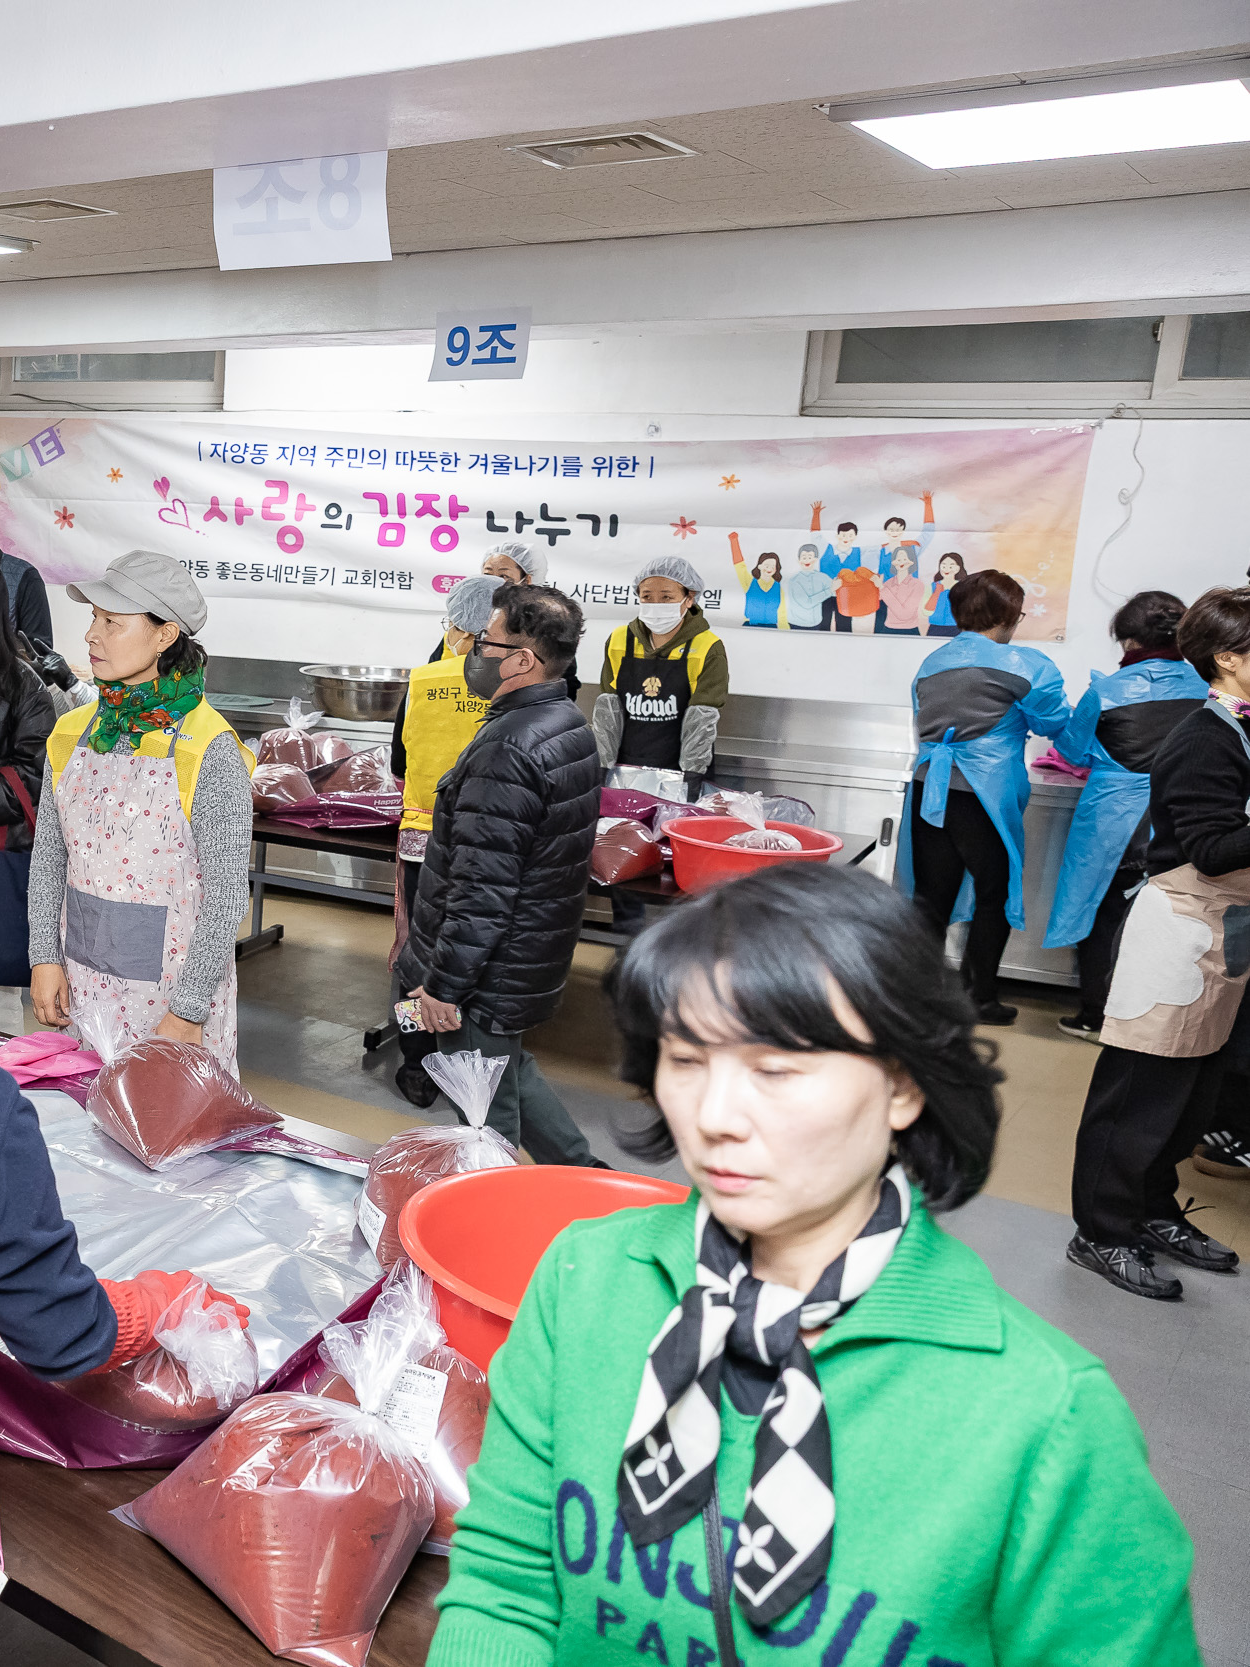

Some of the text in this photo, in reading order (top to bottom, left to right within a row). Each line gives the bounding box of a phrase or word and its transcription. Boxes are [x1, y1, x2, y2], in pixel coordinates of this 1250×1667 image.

[445, 323, 517, 366] 9조
[209, 442, 640, 478] 자양동 지역 주민의 따뜻한 겨울나기를 위한
[203, 479, 619, 554] 사랑의 김장 나누기
[179, 560, 414, 590] 양동 좋은동네만들기 교회연합
[570, 583, 640, 606] 사단법
[426, 687, 462, 700] 광진구
